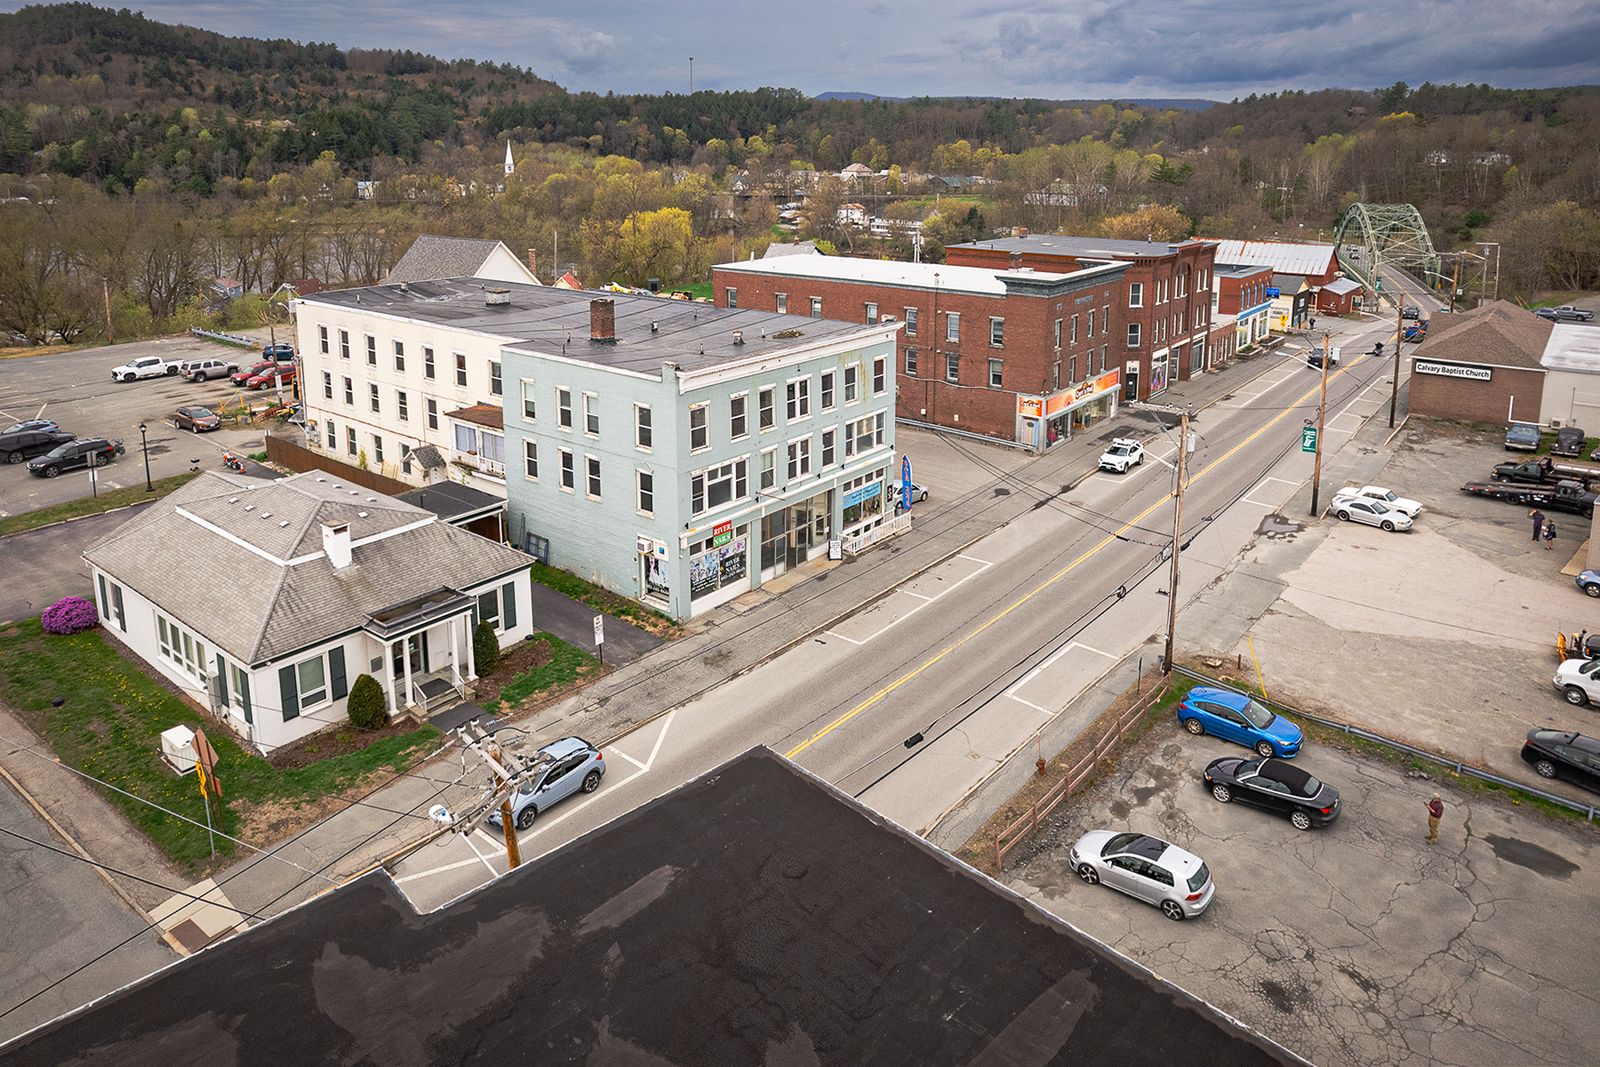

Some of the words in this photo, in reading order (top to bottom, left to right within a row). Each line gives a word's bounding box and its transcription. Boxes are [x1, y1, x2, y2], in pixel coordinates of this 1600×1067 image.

[1417, 364, 1440, 373] Calvary
[1441, 366, 1465, 375] Baptist
[1465, 370, 1489, 378] Church
[714, 524, 731, 536] RIVER
[714, 534, 731, 546] NAILS
